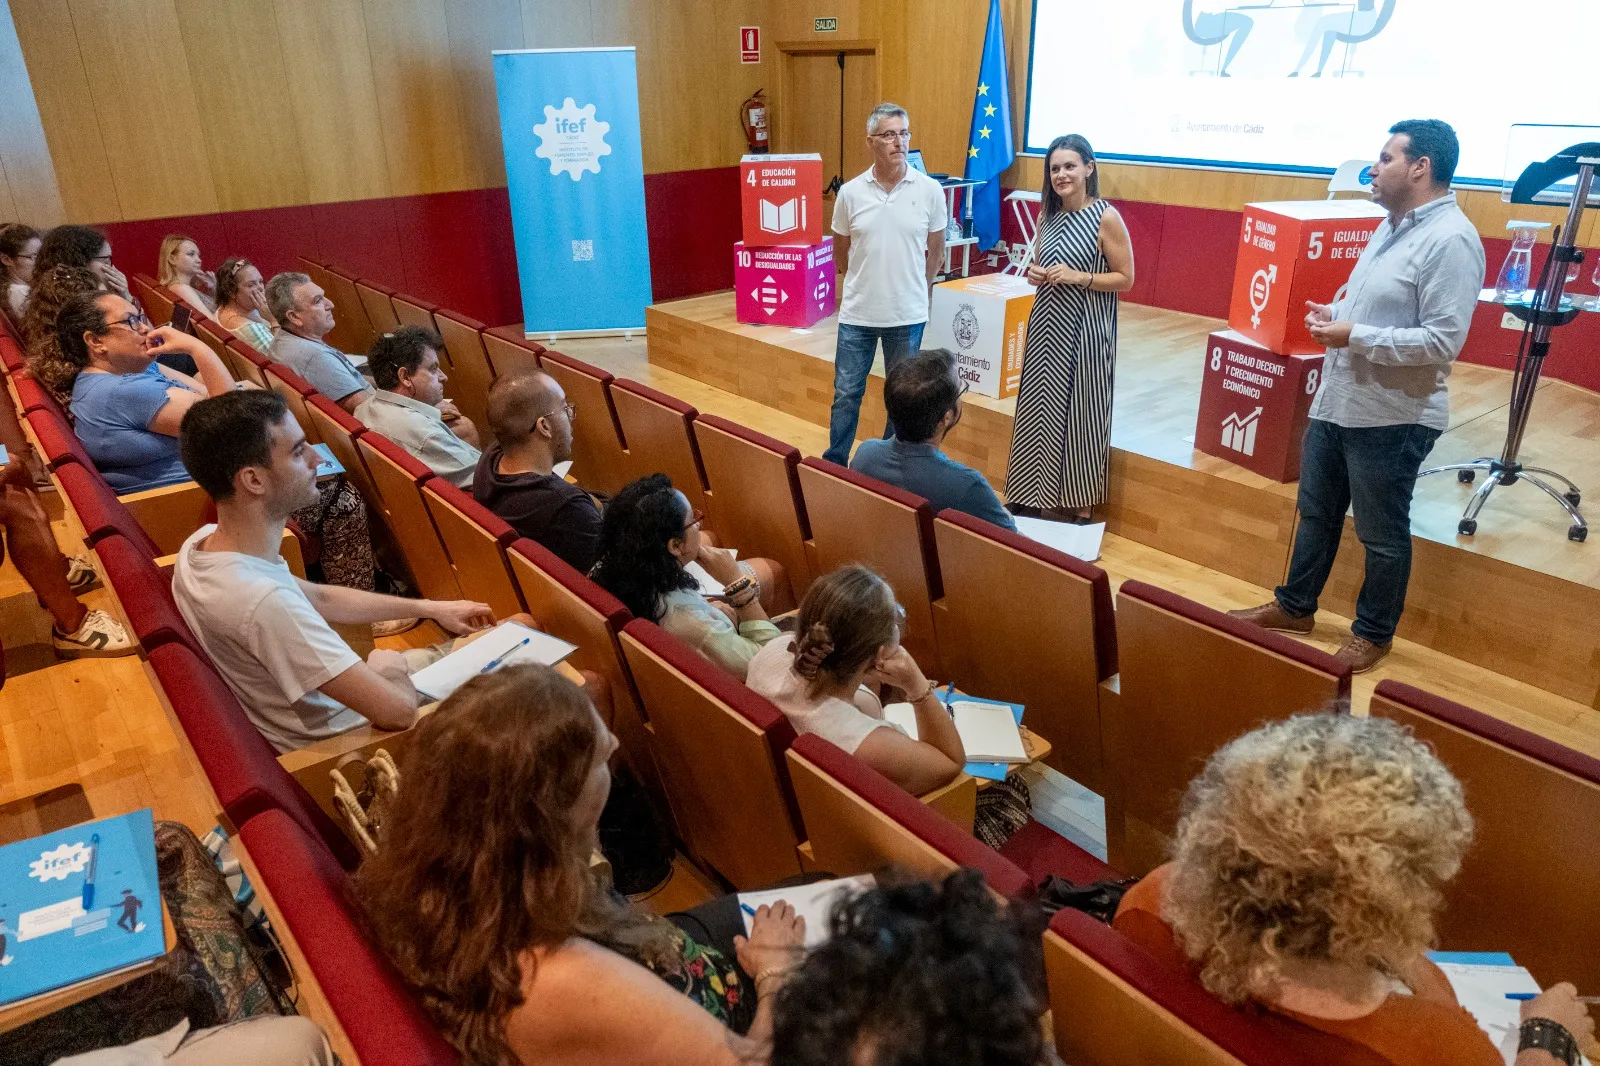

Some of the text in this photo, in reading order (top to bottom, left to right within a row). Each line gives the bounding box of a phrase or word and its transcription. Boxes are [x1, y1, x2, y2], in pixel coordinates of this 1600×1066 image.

[816, 20, 836, 30] SALIDA
[555, 117, 586, 133] ifef
[1243, 123, 1265, 134] Cádiz
[746, 169, 757, 187] 4
[762, 166, 796, 177] EDUCACIÓN
[762, 178, 796, 187] DE CALIDAD
[1244, 217, 1253, 244] 5
[1255, 219, 1277, 236] IGUALDAD
[1253, 235, 1276, 253] DE GÉNERO
[1307, 231, 1324, 260] 5
[1331, 247, 1342, 259] DE
[737, 250, 752, 268] 10
[755, 251, 802, 262] REDUCCIÓN DE LAS
[807, 251, 815, 270] 10
[755, 261, 796, 271] DESIGUALDADES
[1015, 321, 1024, 369] COMUNIDADES
[1007, 338, 1016, 371] CIUDADES
[1210, 346, 1222, 371] 8
[1228, 350, 1286, 377] TRABAJO DECENTE
[958, 366, 981, 383] Cádiz
[1225, 365, 1273, 389] Y CRECIMIENTO
[1305, 369, 1318, 395] 8
[1222, 379, 1260, 400] ECONÓMICO
[44, 851, 82, 870] ifef
